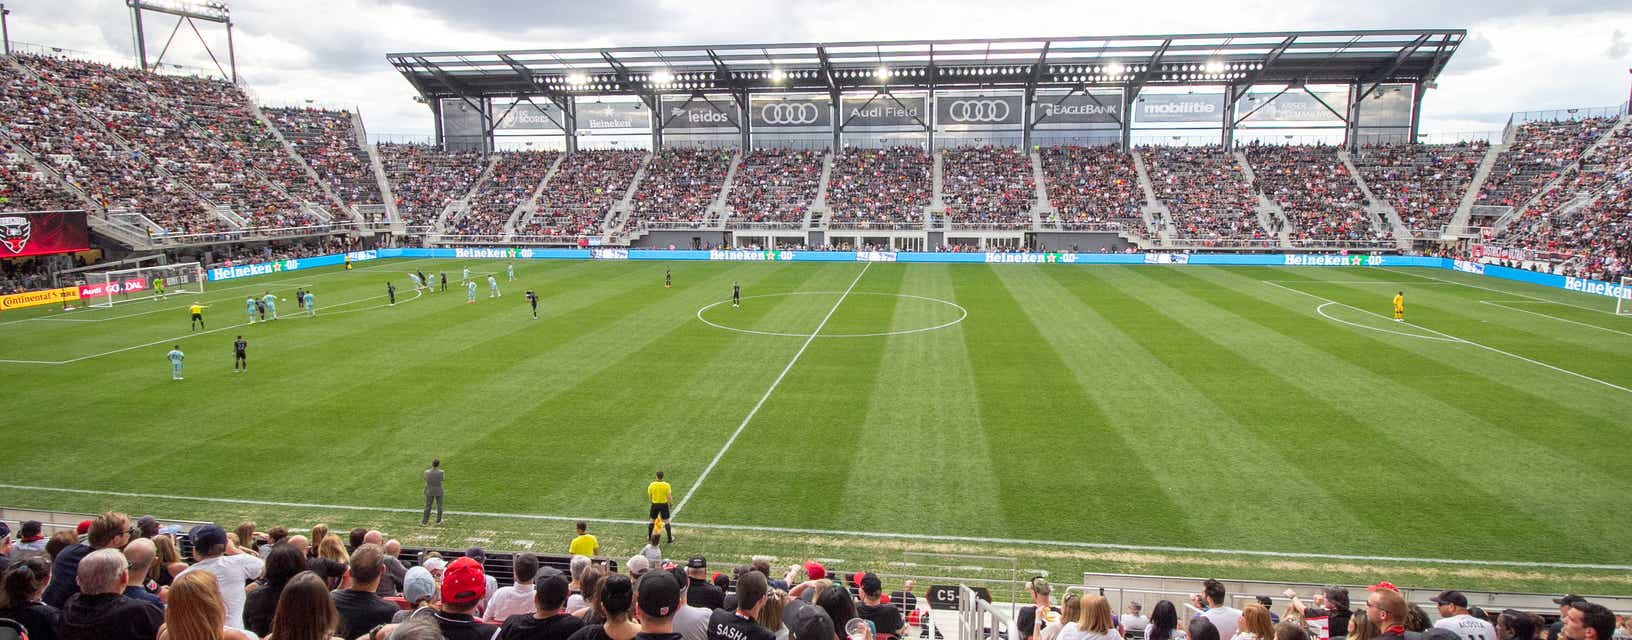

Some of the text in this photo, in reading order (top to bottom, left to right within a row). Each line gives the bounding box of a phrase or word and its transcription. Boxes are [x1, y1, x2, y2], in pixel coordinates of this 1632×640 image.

[850, 106, 917, 118] Audi Field
[1053, 104, 1117, 115] EAGLEBANK
[1144, 101, 1216, 113] mobilitie
[688, 109, 728, 122] leidos
[589, 119, 632, 128] Heineken
[456, 248, 508, 258] Heineken
[710, 250, 765, 260] Heineken
[985, 252, 1045, 263] Heineken
[1285, 254, 1349, 266] Heineken
[214, 263, 273, 280] Heineken
[82, 287, 102, 296] Audi
[1564, 276, 1632, 299] Heineken
[3, 292, 52, 308] Continental
